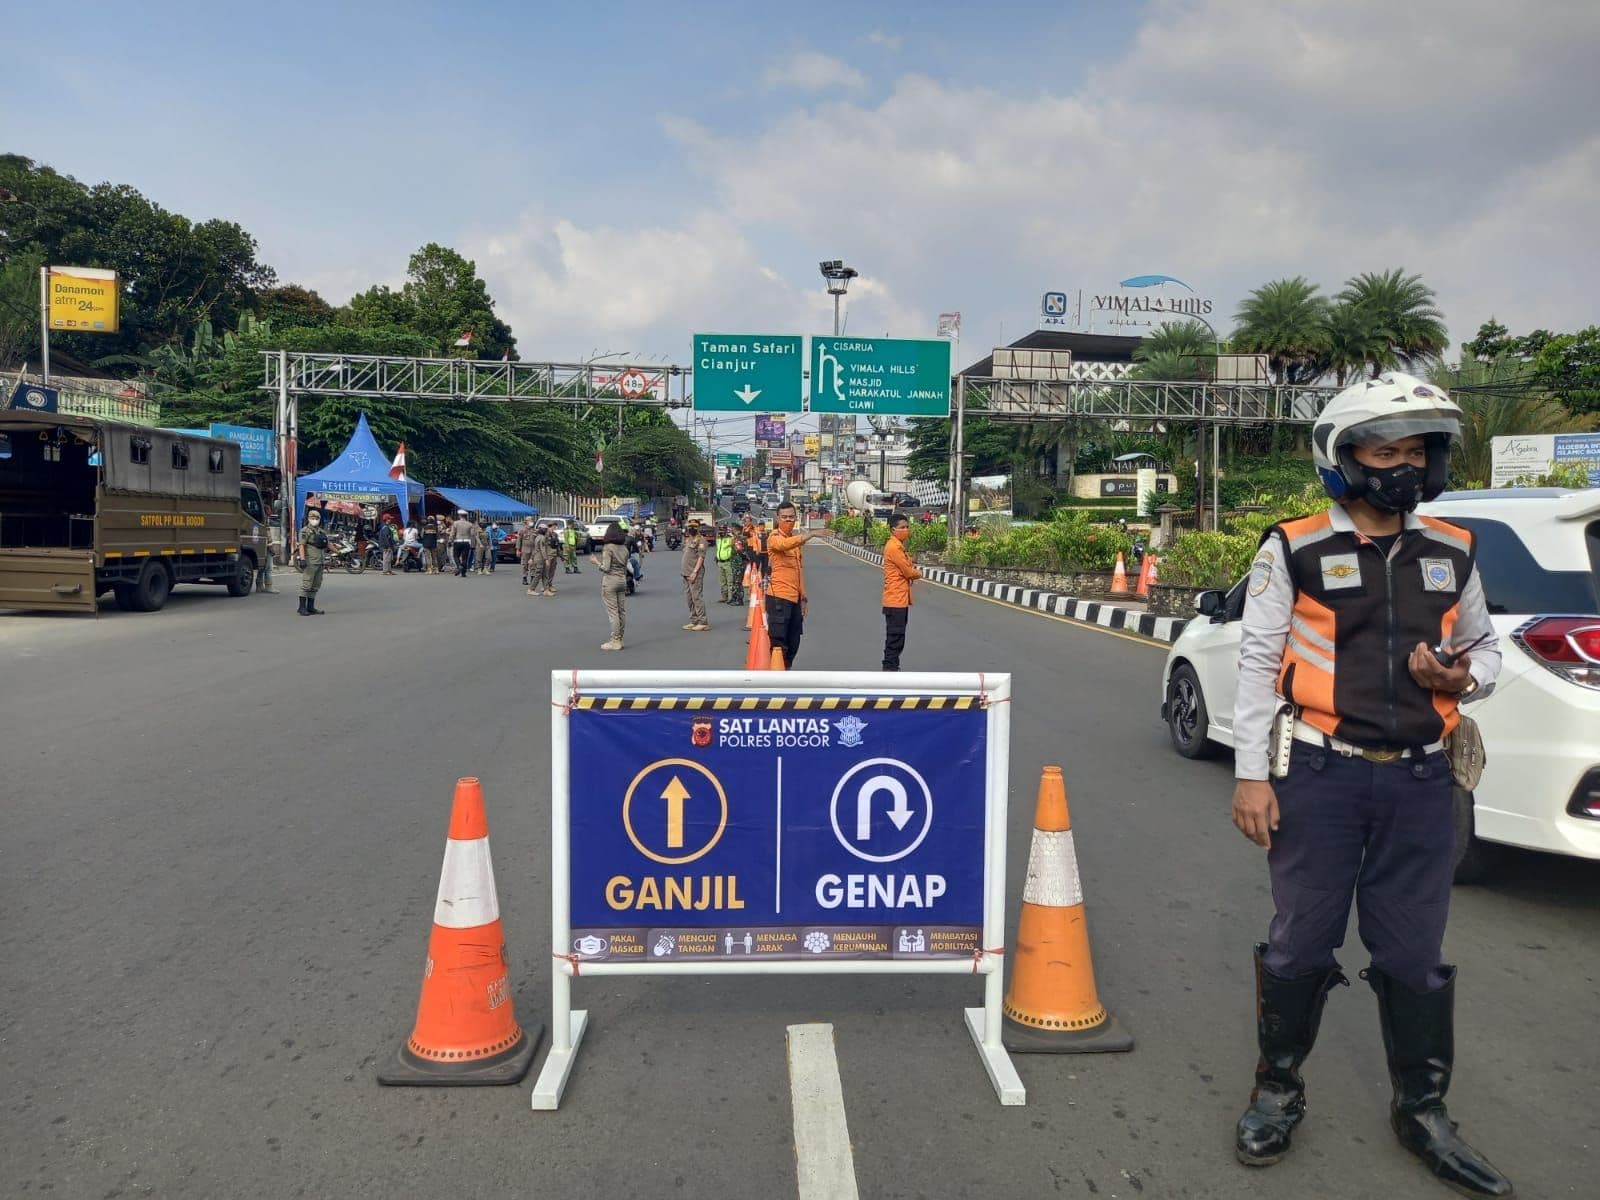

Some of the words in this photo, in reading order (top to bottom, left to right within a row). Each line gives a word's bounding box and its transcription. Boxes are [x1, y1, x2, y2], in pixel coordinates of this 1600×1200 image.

[55, 284, 104, 296] Danamon
[55, 296, 77, 305] atm
[78, 300, 94, 311] 24
[1095, 295, 1164, 317] VIMALA
[701, 342, 747, 353] Taman
[753, 343, 795, 353] Safari
[833, 342, 874, 352] CISARUA
[701, 358, 756, 372] Cianjur
[850, 364, 885, 373] VIMALA
[890, 365, 916, 374] HILLS
[849, 378, 882, 387] MASJID
[849, 388, 902, 398] HARAKATUL
[907, 390, 944, 399] JANNAH
[849, 401, 874, 409] CIAWI
[141, 515, 162, 527] SATPOL
[163, 515, 172, 526] PP
[719, 718, 752, 733] SAT
[758, 718, 830, 733] LANTAS
[719, 735, 771, 748] POLRES
[776, 735, 830, 748] BOGOR
[605, 875, 745, 910] GANJIL
[815, 873, 947, 908] GENAP
[610, 935, 635, 943] PAKAI
[678, 934, 717, 943] MENCUCI
[756, 933, 797, 942] MENJAGA
[833, 933, 877, 941] MENJAUHI
[929, 932, 978, 941] MEMBATASI
[609, 945, 644, 953] MASKER
[677, 945, 715, 953] TANGAN
[756, 944, 783, 952] JARAK
[833, 943, 888, 951] KERUMUNAN
[929, 942, 976, 950] MOBILITAS
